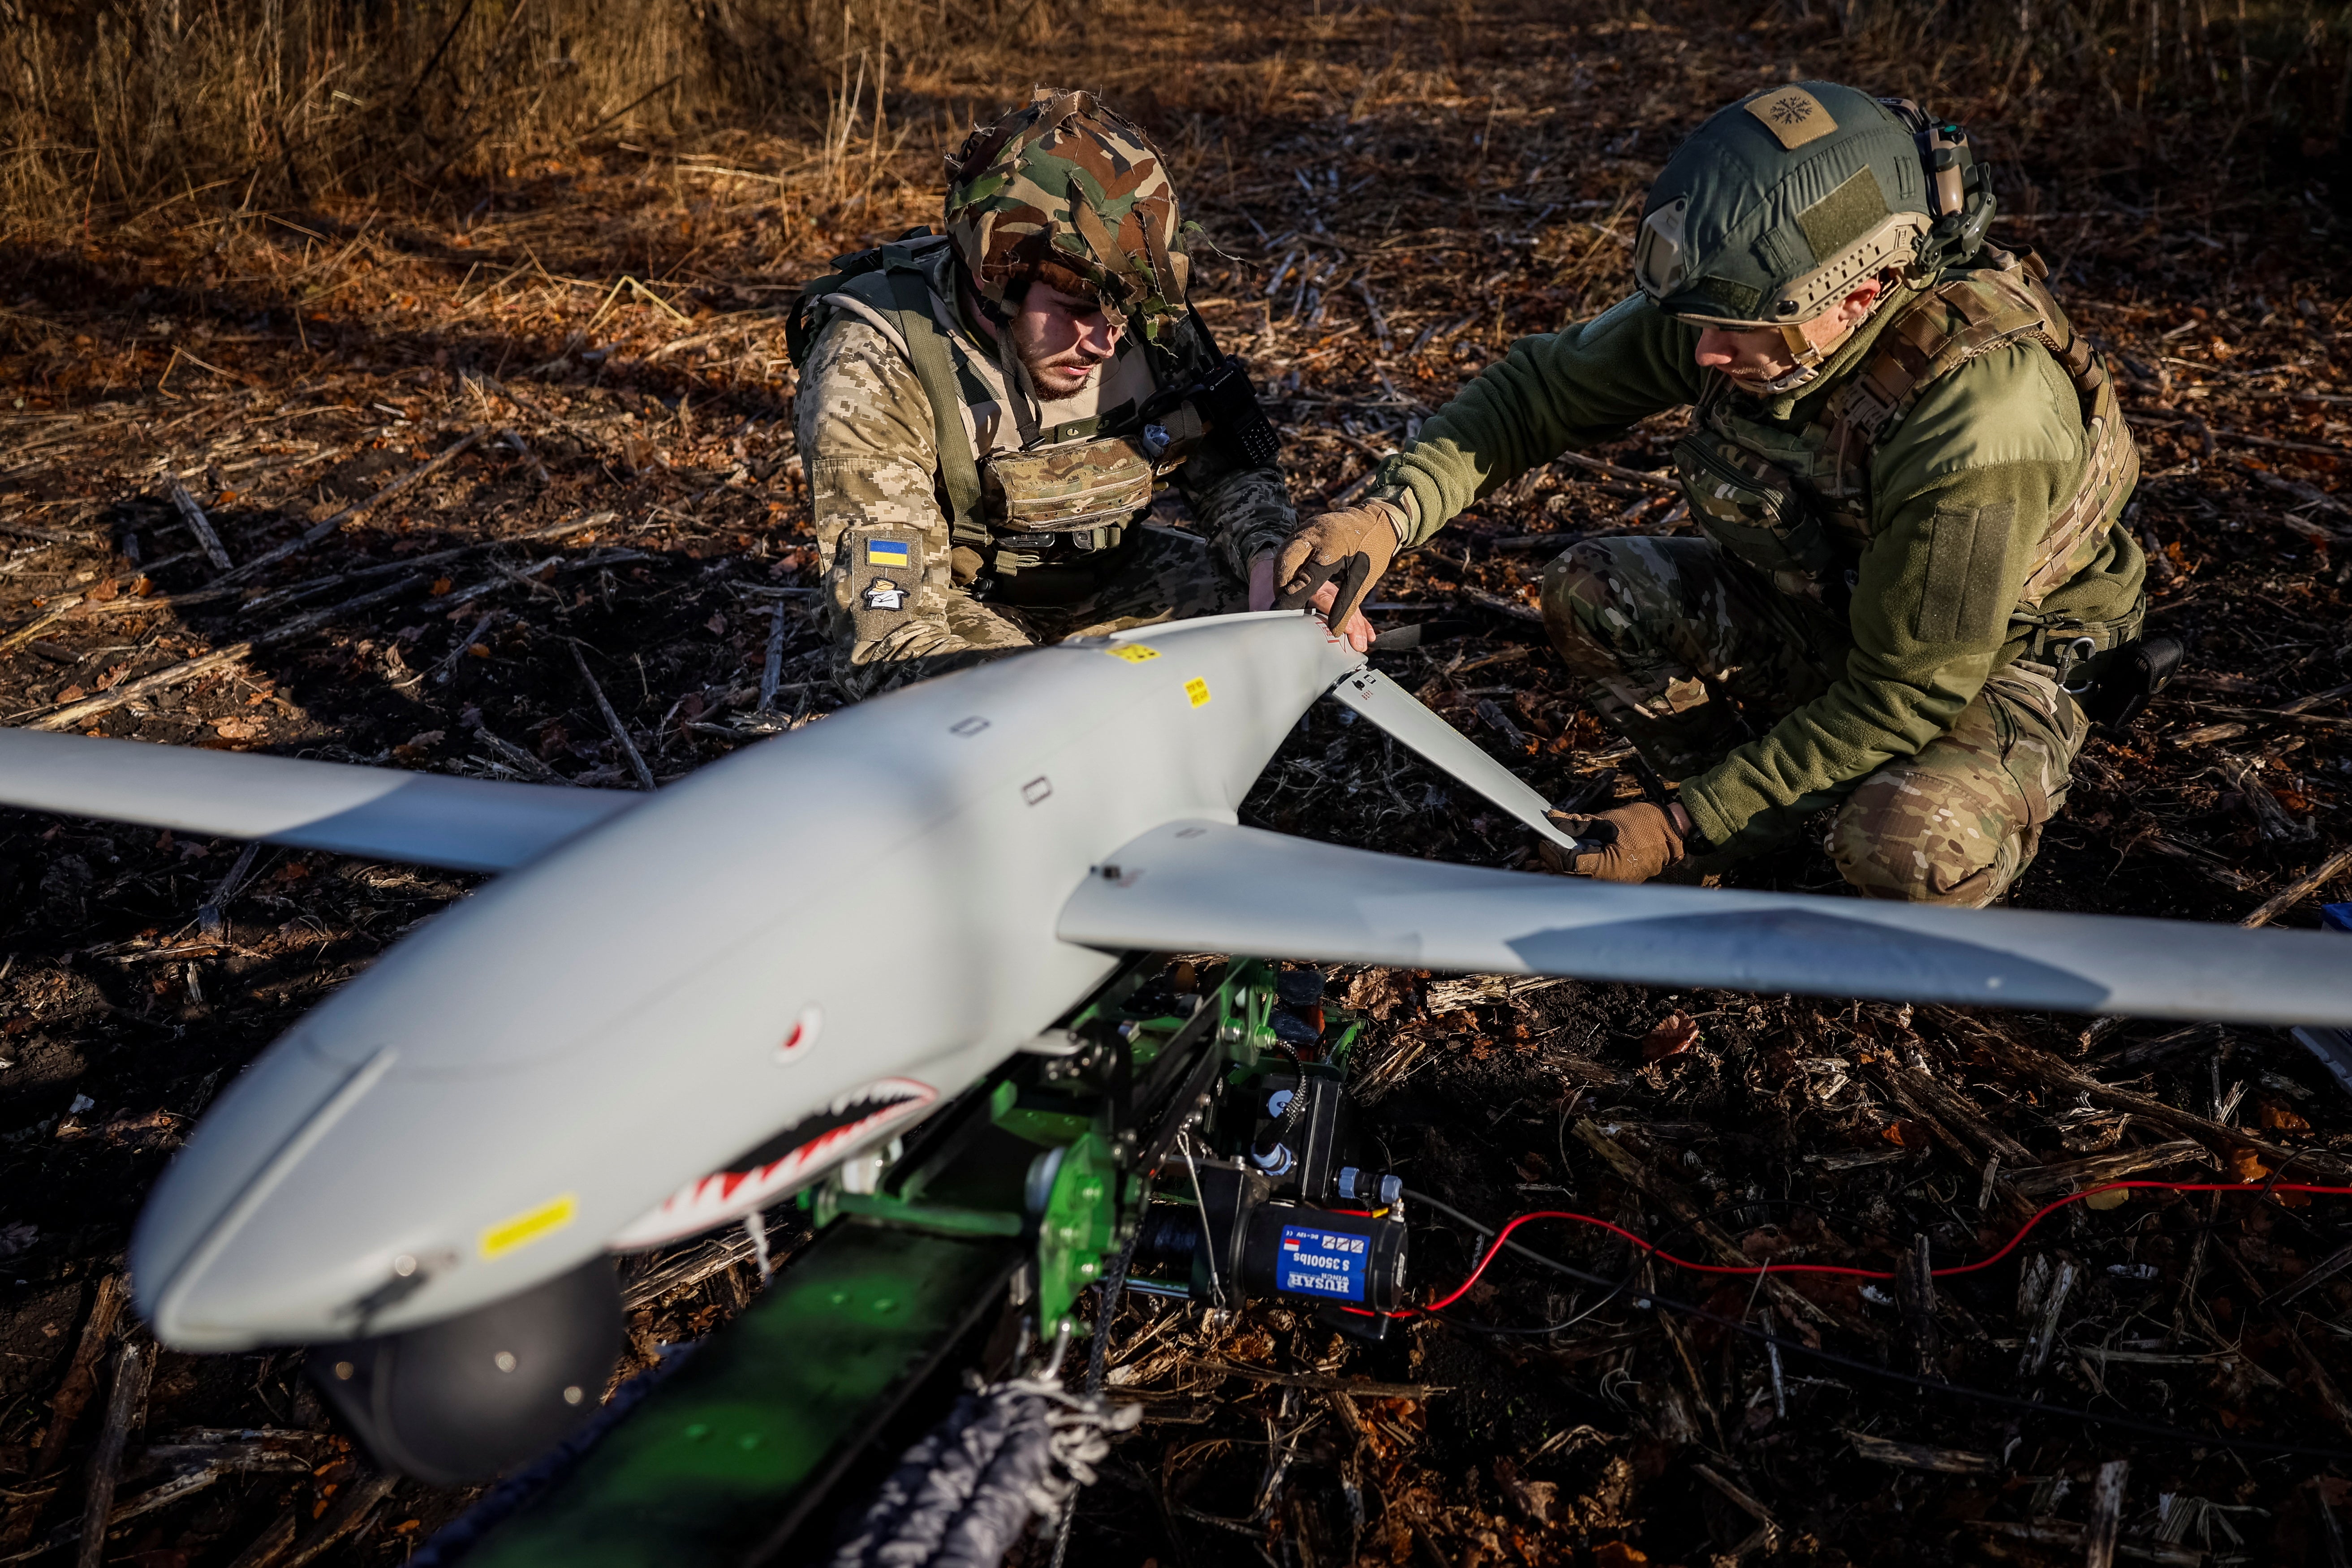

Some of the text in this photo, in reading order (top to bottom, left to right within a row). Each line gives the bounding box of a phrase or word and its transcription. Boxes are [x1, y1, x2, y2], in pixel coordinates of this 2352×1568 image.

[1215, 370, 1234, 386] MOTOROLA
[1293, 1253, 1350, 1271] S 3500lbs
[1290, 1273, 1349, 1293] HUSAR
[1321, 1273, 1349, 1282] WINCH
